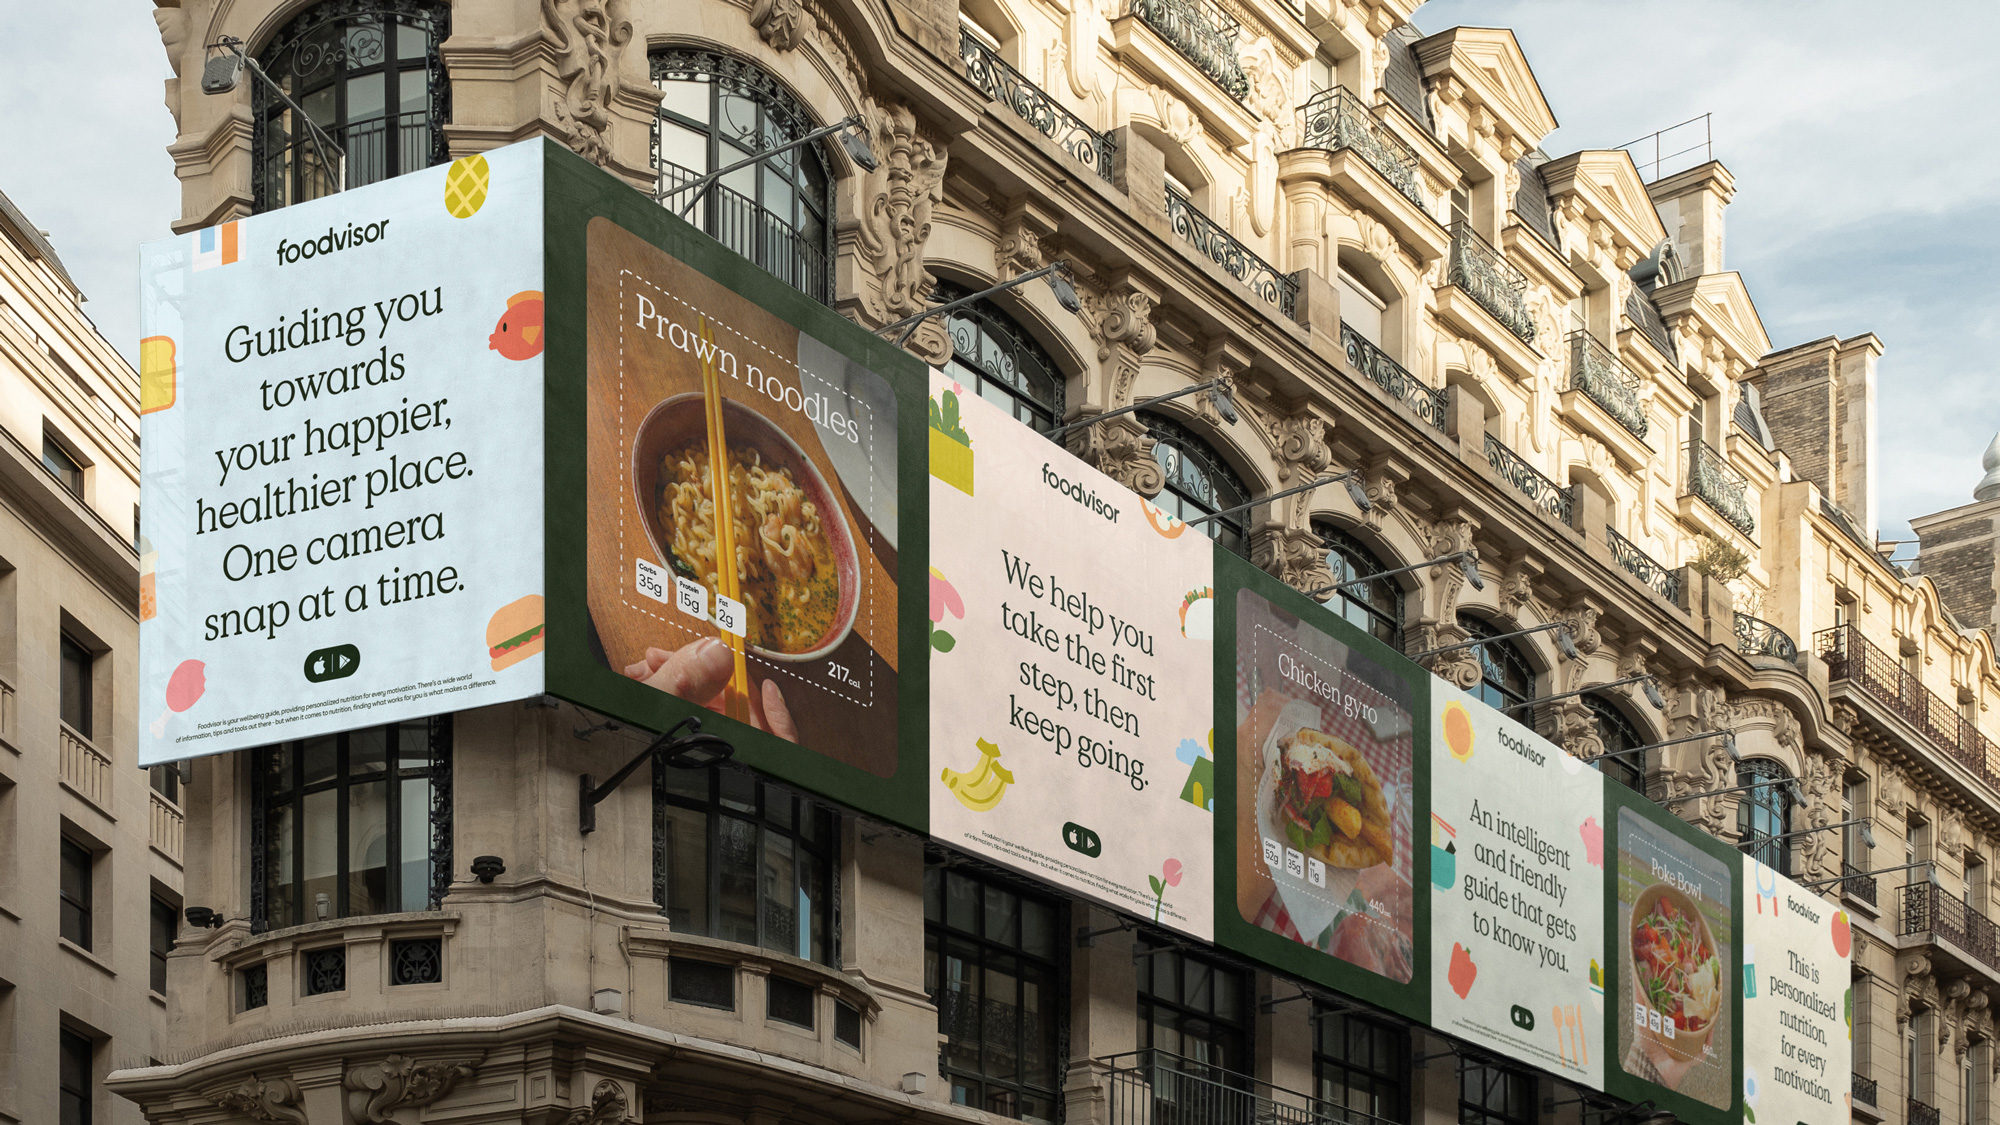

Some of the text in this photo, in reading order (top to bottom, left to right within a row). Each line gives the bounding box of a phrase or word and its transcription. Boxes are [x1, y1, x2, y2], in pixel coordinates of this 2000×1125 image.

[277, 219, 389, 265] foodvisor
[225, 287, 443, 362] Guiding you
[260, 345, 405, 410] towards
[636, 293, 859, 443] Prawn noodles
[215, 398, 451, 486] your happier,
[197, 450, 473, 534] healthier place.
[1042, 463, 1120, 523] foodvisor
[223, 512, 444, 581] One camera
[639, 563, 657, 575] Carbs
[205, 567, 464, 641] snap at a time.
[639, 574, 662, 597] 35g
[680, 581, 699, 594] Protein
[680, 591, 699, 613] 15g
[719, 598, 728, 607] Fat
[1002, 550, 1154, 657] We help you
[719, 609, 733, 628] 2g
[828, 662, 849, 683] 217
[1002, 602, 1156, 701] take the first
[198, 720, 221, 730] Foodvisor
[227, 717, 238, 725] your
[239, 712, 264, 722] wellbeing
[280, 704, 305, 715] providing
[305, 697, 339, 711] personalized
[340, 694, 362, 703] nutrition
[442, 676, 455, 684] wide
[456, 672, 472, 682] world
[1020, 662, 1139, 737] step, then
[1278, 653, 1341, 705] Chicken
[1344, 694, 1378, 724] gyro
[181, 731, 212, 742] information,
[223, 725, 234, 734] and
[234, 723, 247, 732] tools
[248, 721, 257, 729] out
[275, 716, 284, 724] but
[284, 714, 299, 723] when
[304, 711, 321, 719] comes
[328, 705, 352, 714] nutrition,
[353, 701, 371, 710] finding
[372, 697, 386, 707] what
[386, 695, 403, 704] works
[411, 692, 422, 700] you
[428, 687, 443, 696] what
[443, 684, 462, 693] makes
[1010, 695, 1148, 790] keep going.
[1498, 727, 1545, 767] foodvisor
[1266, 849, 1278, 865] 52g
[1470, 799, 1570, 871] An intelligent
[1288, 859, 1300, 874] 35g
[1310, 868, 1319, 882] 11g
[1475, 844, 1567, 907] and friendly
[1652, 858, 1702, 900] Poke Bowl
[1370, 899, 1384, 914] 440
[1464, 875, 1576, 941] guide that gets
[1788, 895, 1820, 924] foodvisor
[1473, 911, 1569, 972] to know you.
[1788, 950, 1820, 984] This is
[1770, 976, 1836, 1021] personalized
[1780, 1010, 1827, 1047] nutrition,
[1781, 1035, 1826, 1077] for every
[1774, 1066, 1832, 1104] motivation.
